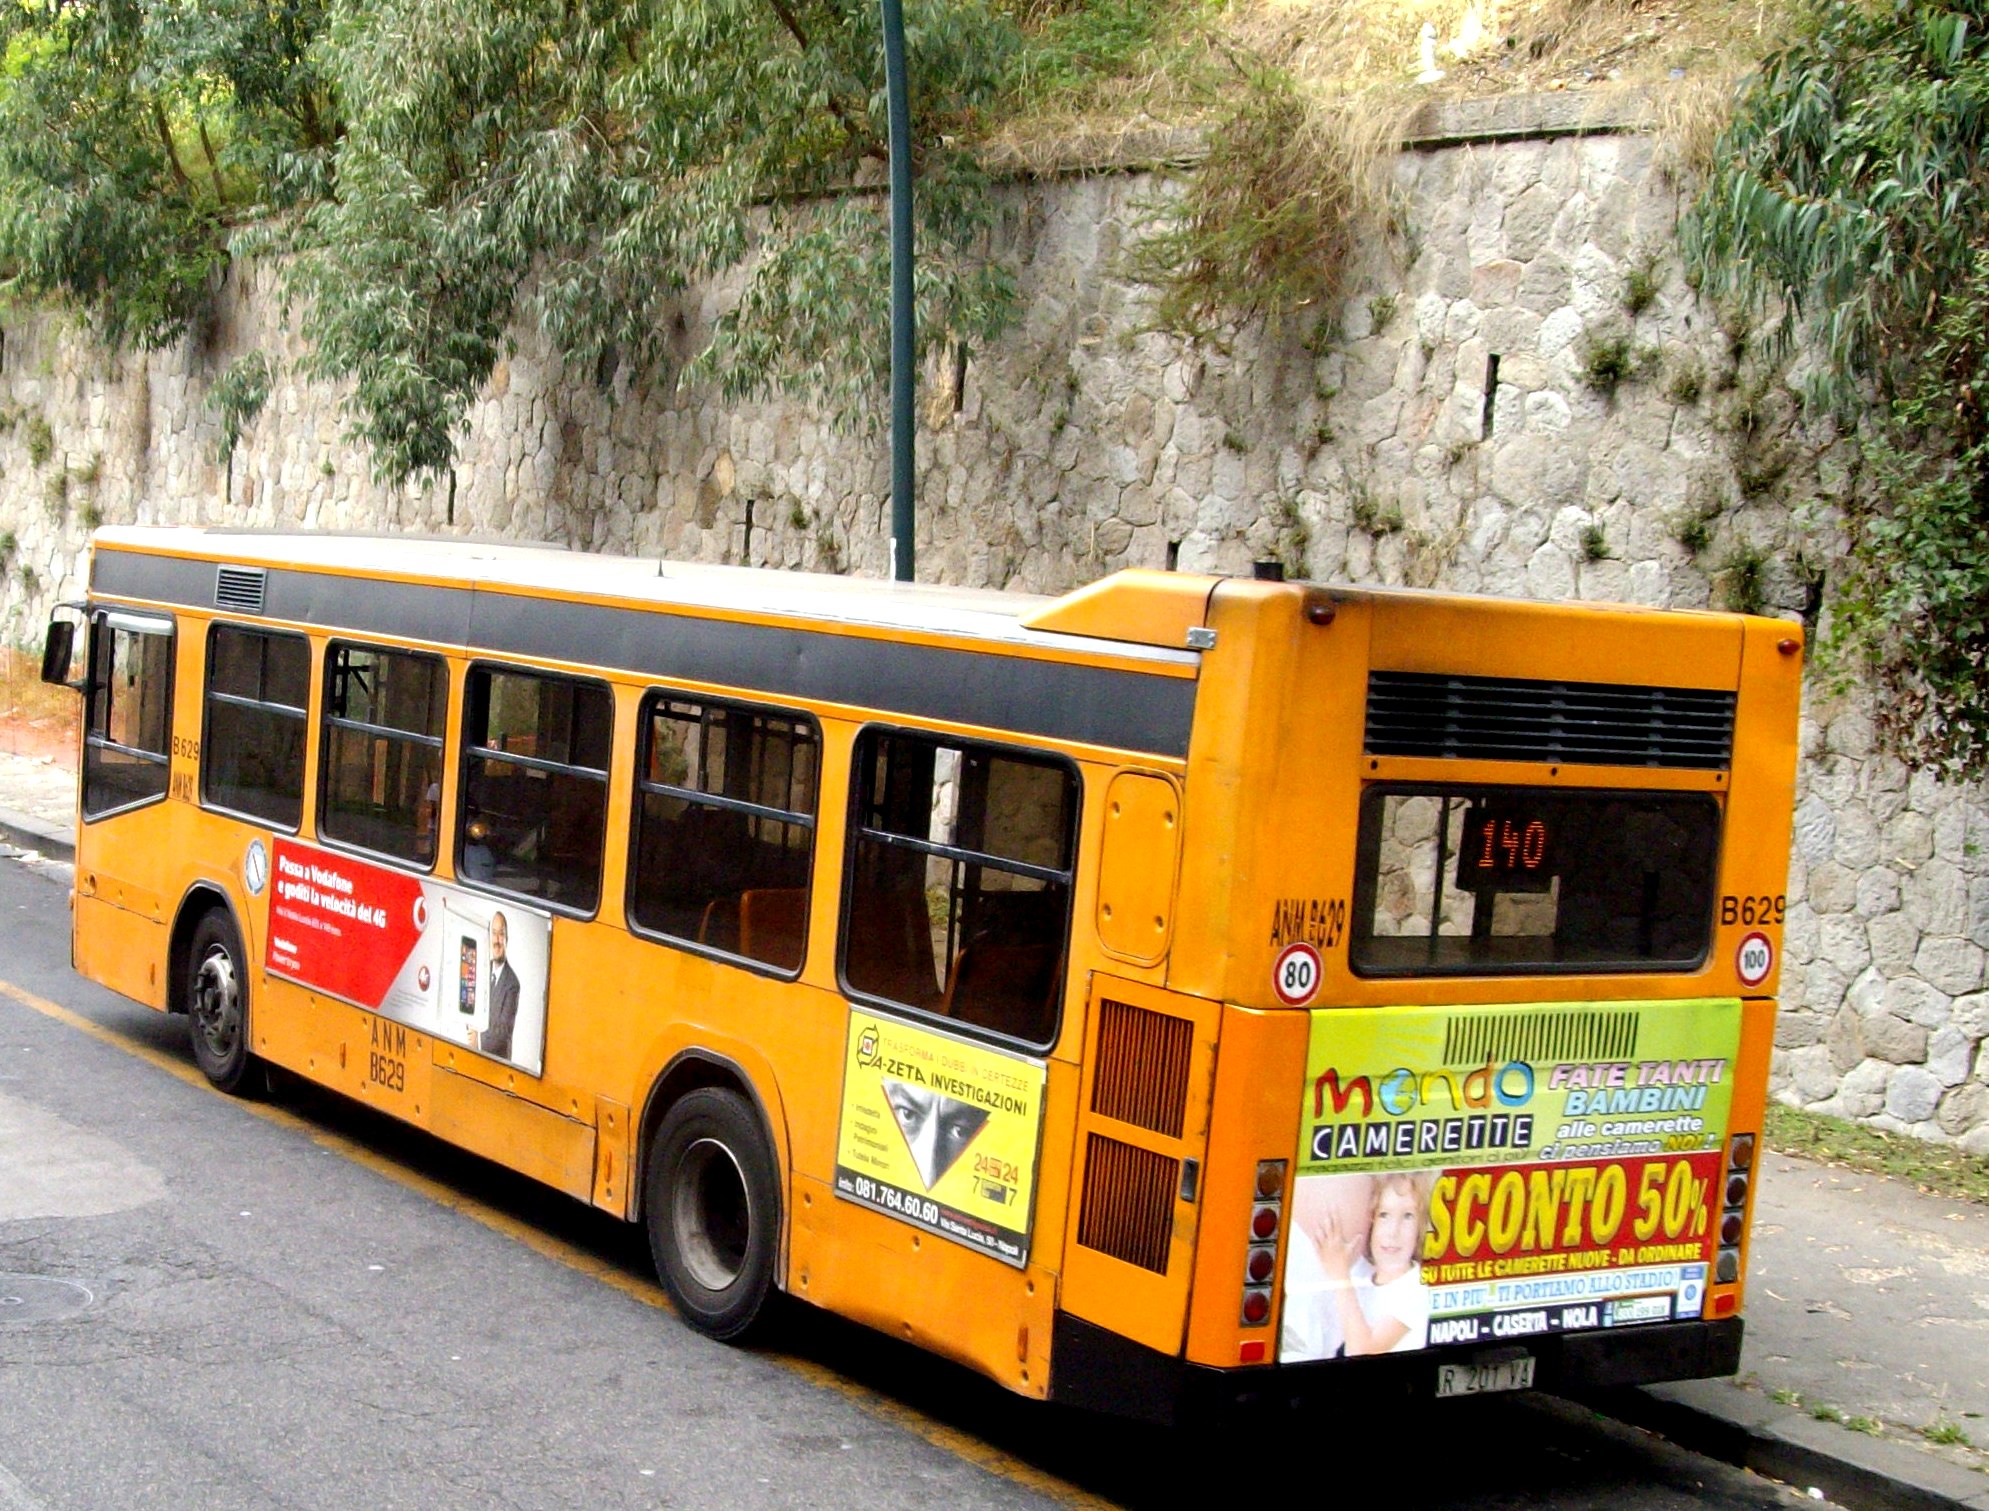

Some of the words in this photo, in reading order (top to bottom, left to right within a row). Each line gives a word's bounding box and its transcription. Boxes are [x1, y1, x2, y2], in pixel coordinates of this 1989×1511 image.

[173, 736, 199, 760] B629
[1479, 820, 1546, 868] 140
[279, 855, 303, 878] Passa
[305, 867, 310, 880] a
[311, 864, 353, 895] Vodafone
[278, 880, 284, 893] e
[285, 882, 309, 902] goditi
[311, 888, 319, 905] la
[321, 894, 356, 918] velocità
[357, 903, 372, 924] del
[373, 908, 386, 928] 4G
[1721, 895, 1786, 925] B629
[1285, 961, 1311, 989] 80
[1744, 950, 1766, 970] 100
[370, 1052, 405, 1092] B629
[883, 1038, 934, 1063] TRASFORMA
[941, 1055, 968, 1073] DUBBI
[982, 1069, 1029, 1092] CERTEZZE
[1549, 1062, 1631, 1089] FATE
[1637, 1058, 1727, 1086] TANTI
[870, 1056, 926, 1085] A-ZETA
[930, 1072, 1027, 1117] INVESTIGAZIONI
[1563, 1085, 1707, 1117] BAMBINI
[1311, 1116, 1533, 1160] CAMERETTE
[1557, 1119, 1596, 1139] alle
[1600, 1115, 1703, 1137] camerette
[974, 1152, 988, 1174] 24
[1003, 1162, 1019, 1185] 24
[1538, 1141, 1560, 1160] ci
[1561, 1139, 1662, 1160] pensiamo
[855, 1177, 938, 1224] 081.764.60.60
[973, 1175, 981, 1194] 7
[1009, 1187, 1018, 1206] 7
[1422, 1163, 1628, 1260] SCONTO
[1632, 1159, 1709, 1243] 50%
[1420, 1265, 1438, 1285] SU
[1440, 1261, 1476, 1282] TUTTE
[1477, 1260, 1493, 1278] LE
[1494, 1253, 1567, 1277] CAMERETTE
[1567, 1250, 1611, 1270] NUOVE
[1618, 1247, 1635, 1265] DA
[1637, 1242, 1703, 1263] ORDINARE
[1432, 1293, 1441, 1310] E
[1443, 1291, 1458, 1308] IN
[1498, 1284, 1511, 1302] TI
[1514, 1274, 1585, 1301] PORTIAMO
[1588, 1272, 1622, 1294] ALLO
[1430, 1318, 1479, 1344] NAPOLI
[1492, 1311, 1548, 1337] CASERTA
[1561, 1306, 1599, 1329] NOLA
